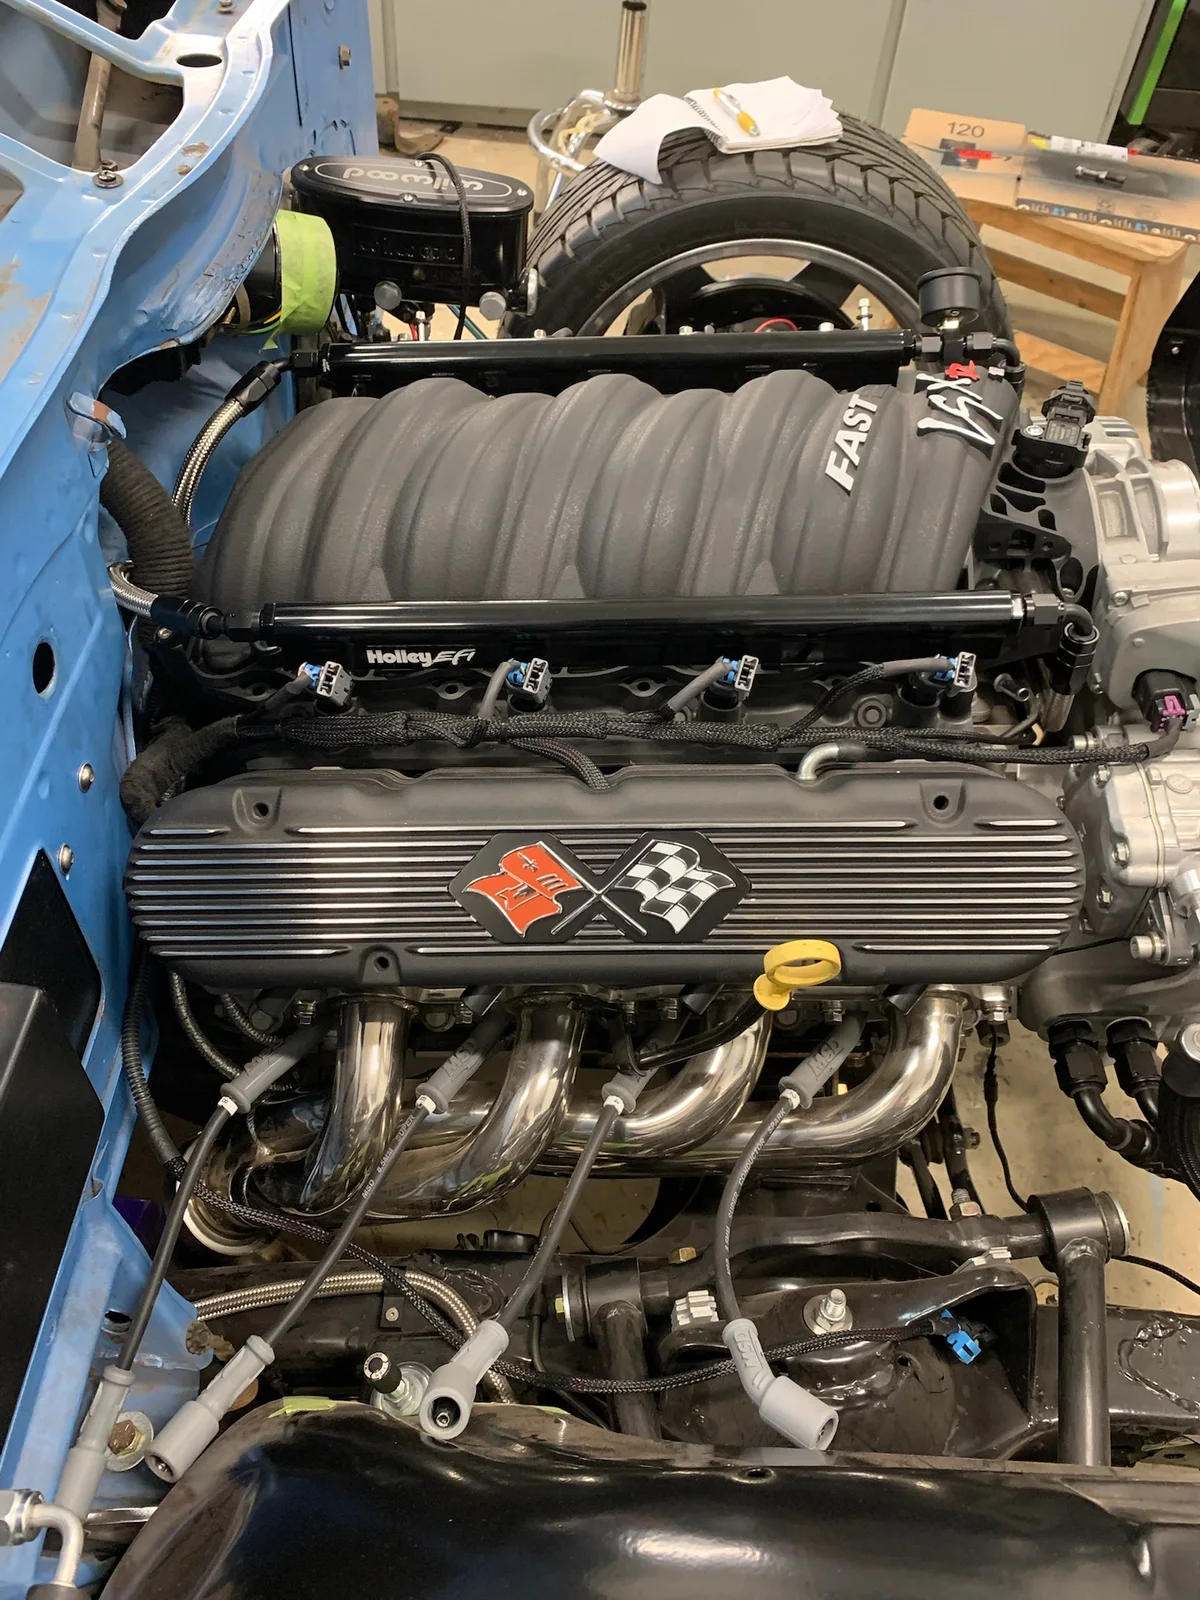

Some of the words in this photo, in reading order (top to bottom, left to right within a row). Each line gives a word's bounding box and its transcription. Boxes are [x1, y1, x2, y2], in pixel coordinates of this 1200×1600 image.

[947, 122, 985, 138] 120
[342, 167, 484, 191] wilwood
[825, 394, 878, 491] FAST
[366, 649, 434, 668] Holley
[433, 648, 476, 666] EFI
[361, 1178, 375, 1200] MSD
[376, 1146, 395, 1174] 8.5MM
[395, 1113, 416, 1143] SUPER
[738, 1137, 765, 1186] CONDUCTOR
[767, 1107, 786, 1134] SPARK
